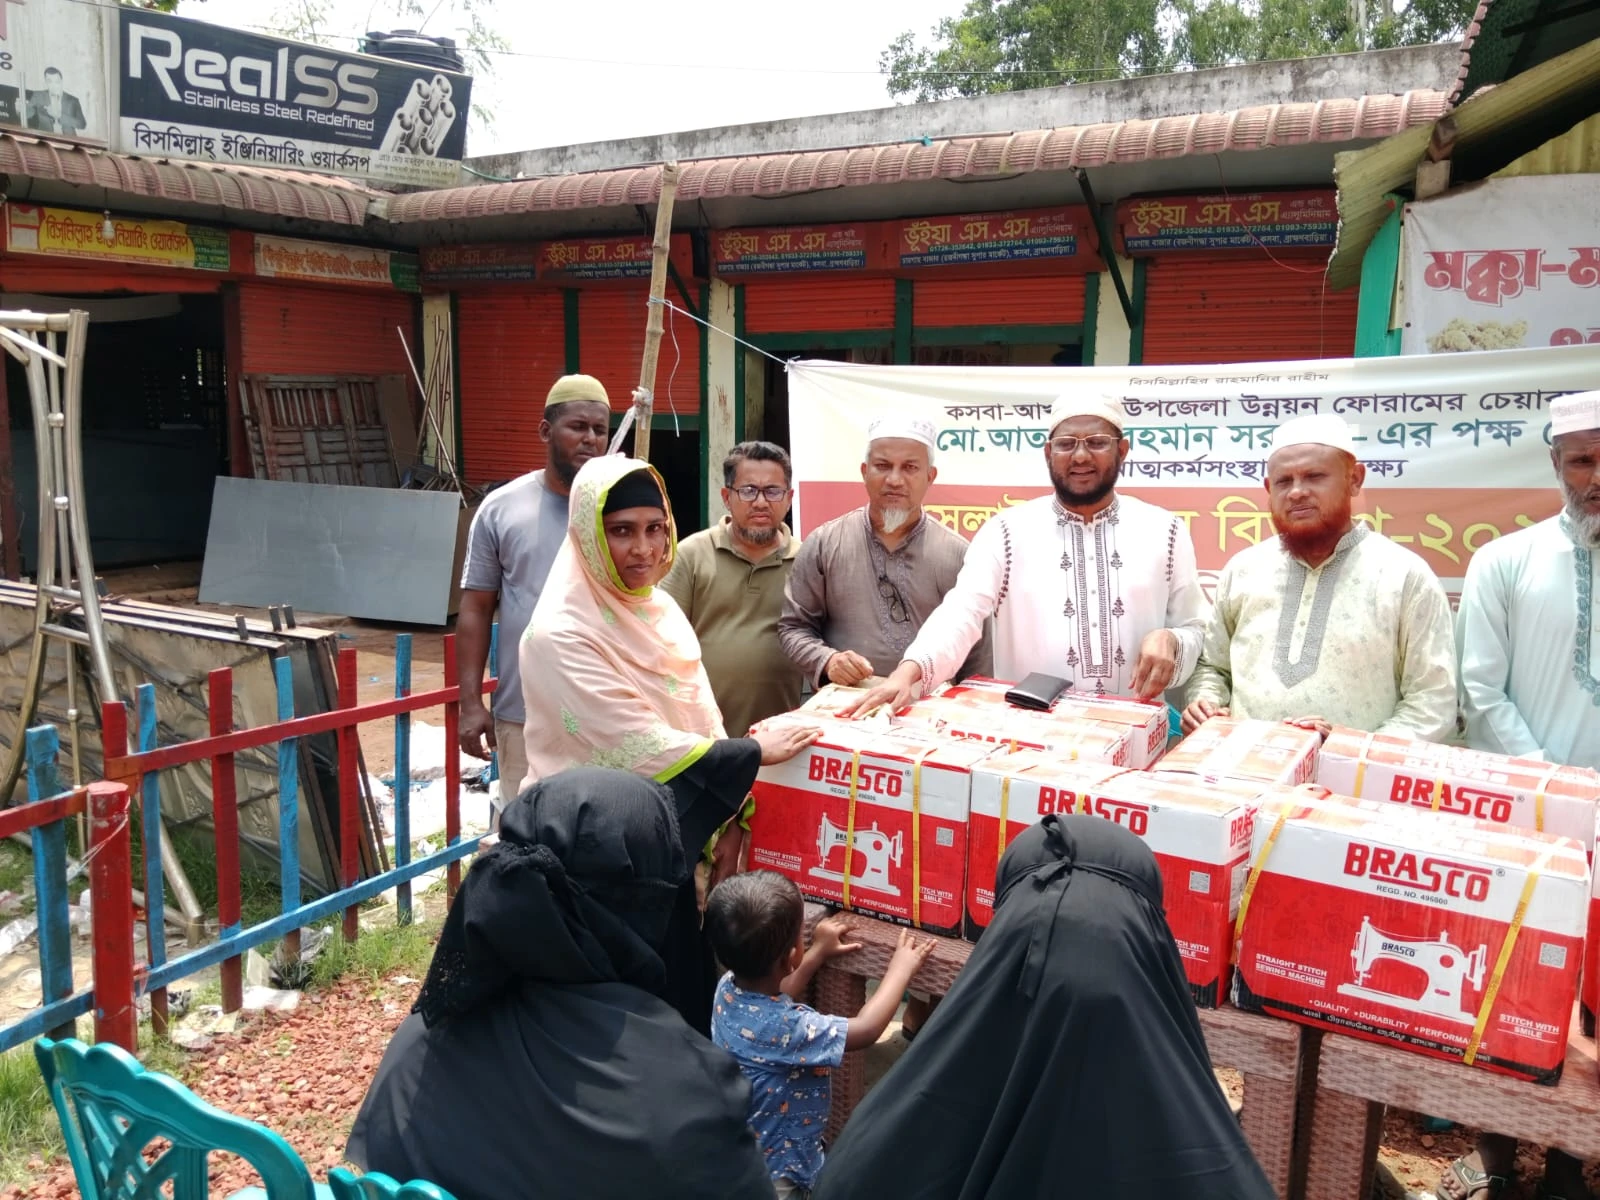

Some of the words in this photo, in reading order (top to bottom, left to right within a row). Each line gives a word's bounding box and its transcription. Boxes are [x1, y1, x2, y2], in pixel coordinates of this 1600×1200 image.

[184, 91, 260, 114] Stainless
[264, 103, 302, 121] Steel
[306, 109, 375, 132] Redefined
[221, 133, 304, 166] ইঞ্জিনিয়ারিং
[310, 148, 371, 173] ওয়ার্কসপ
[1288, 371, 1330, 382] রাহীম
[1121, 396, 1230, 418] উপজেলা
[1239, 393, 1322, 419] উন্নয়ন
[1333, 392, 1467, 413] ফোরামের
[937, 426, 1049, 452] মো.আত
[1226, 425, 1280, 450] সর
[1452, 418, 1528, 448] পক্ষ
[1119, 454, 1268, 480] ত্মকর্মসংস্থা
[808, 754, 904, 797] BRASCO
[1390, 774, 1515, 824] BRASCO
[1344, 842, 1493, 903] BRASCO
[1376, 884, 1401, 896] REGD.
[1404, 890, 1418, 899] NO.
[863, 898, 907, 914] PERFORMANCE
[1179, 948, 1197, 958] MILE
[1381, 942, 1416, 957] BRASCO
[1255, 953, 1296, 969] STRAIGHT
[1298, 964, 1328, 977] STITCH
[1255, 963, 1287, 977] SEWING
[1288, 971, 1326, 987] MACHINE
[1313, 1000, 1350, 1014] QUALITY
[1359, 1011, 1410, 1030] DURABILITY
[1500, 1013, 1533, 1028] STITCH
[1535, 1021, 1560, 1034] WITH
[1513, 1026, 1543, 1039] SMILE
